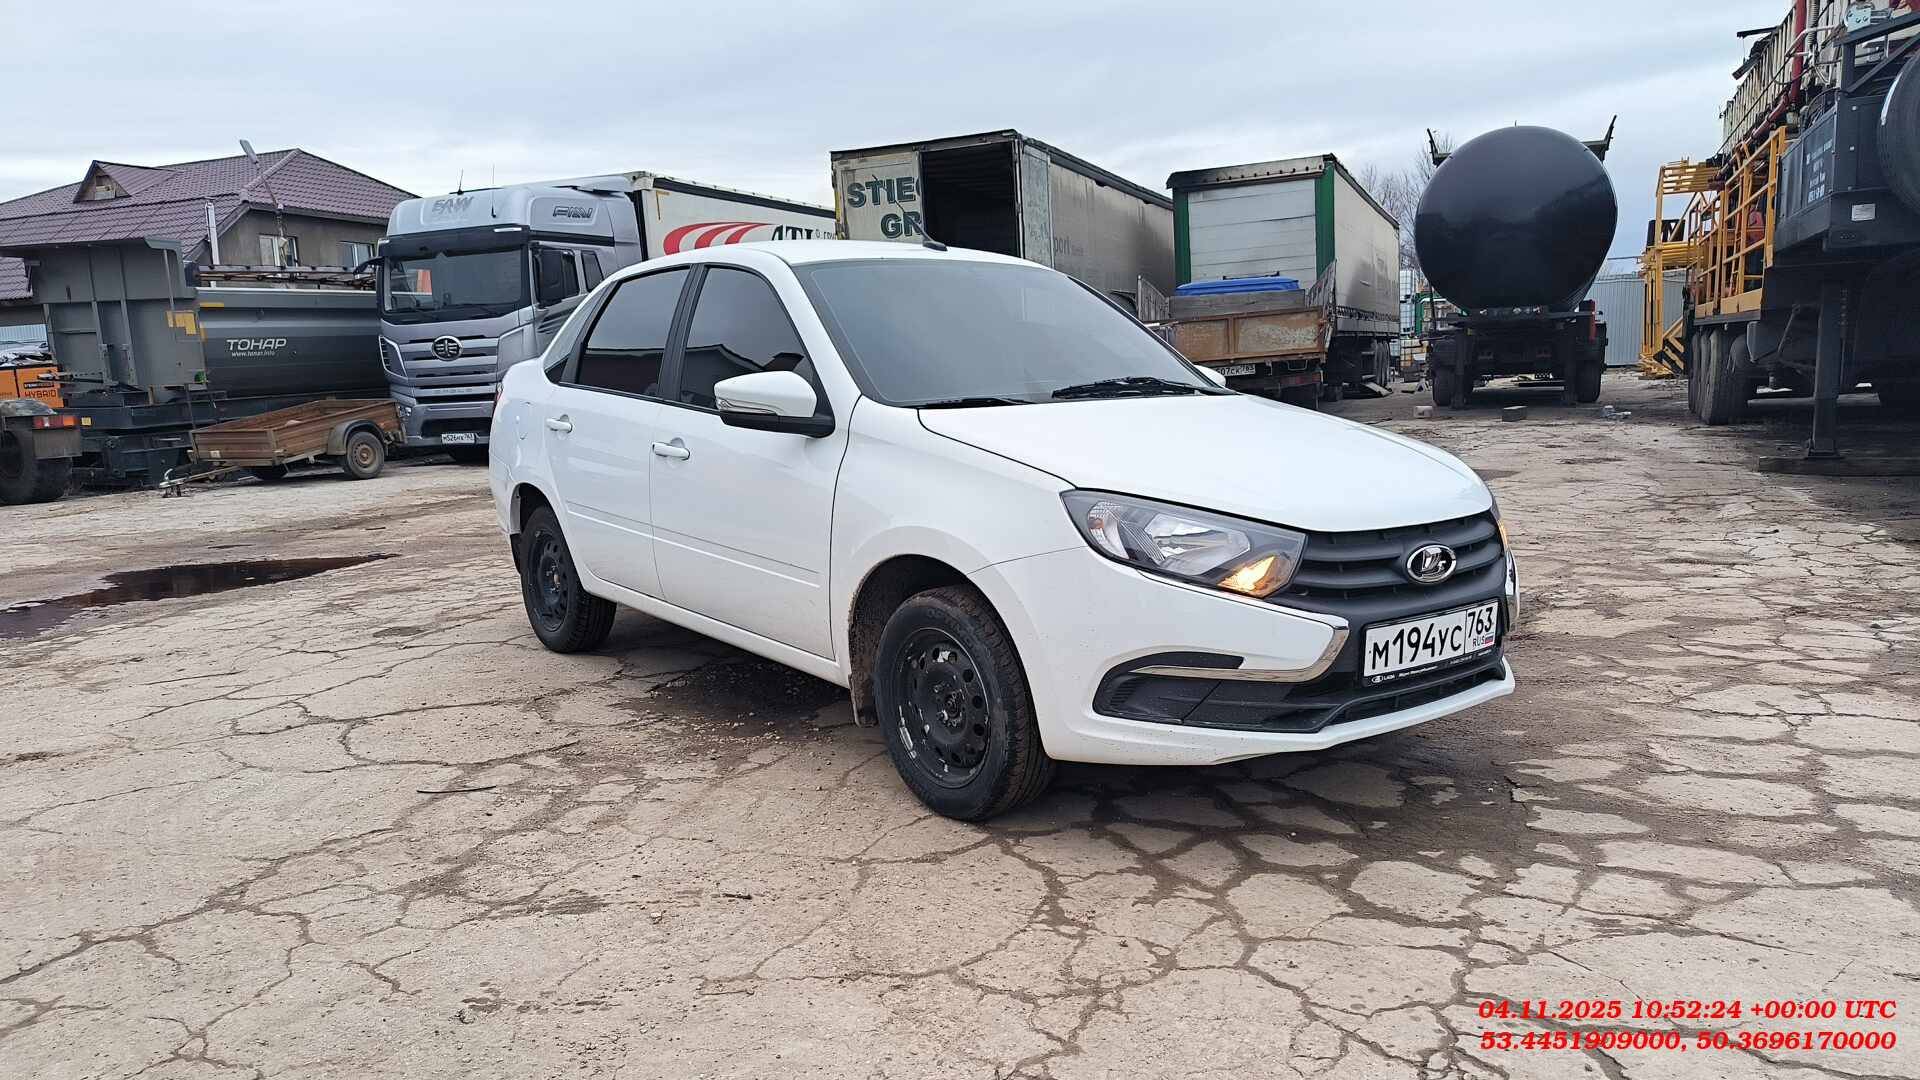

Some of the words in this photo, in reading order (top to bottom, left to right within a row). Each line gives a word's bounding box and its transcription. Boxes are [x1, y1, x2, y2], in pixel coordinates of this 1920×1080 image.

[226, 338, 287, 351] ТОНАР
[24, 389, 57, 398] HYBRID
[1372, 623, 1463, 670] М194УС
[1467, 606, 1494, 639] 763
[1472, 637, 1486, 647] RUS
